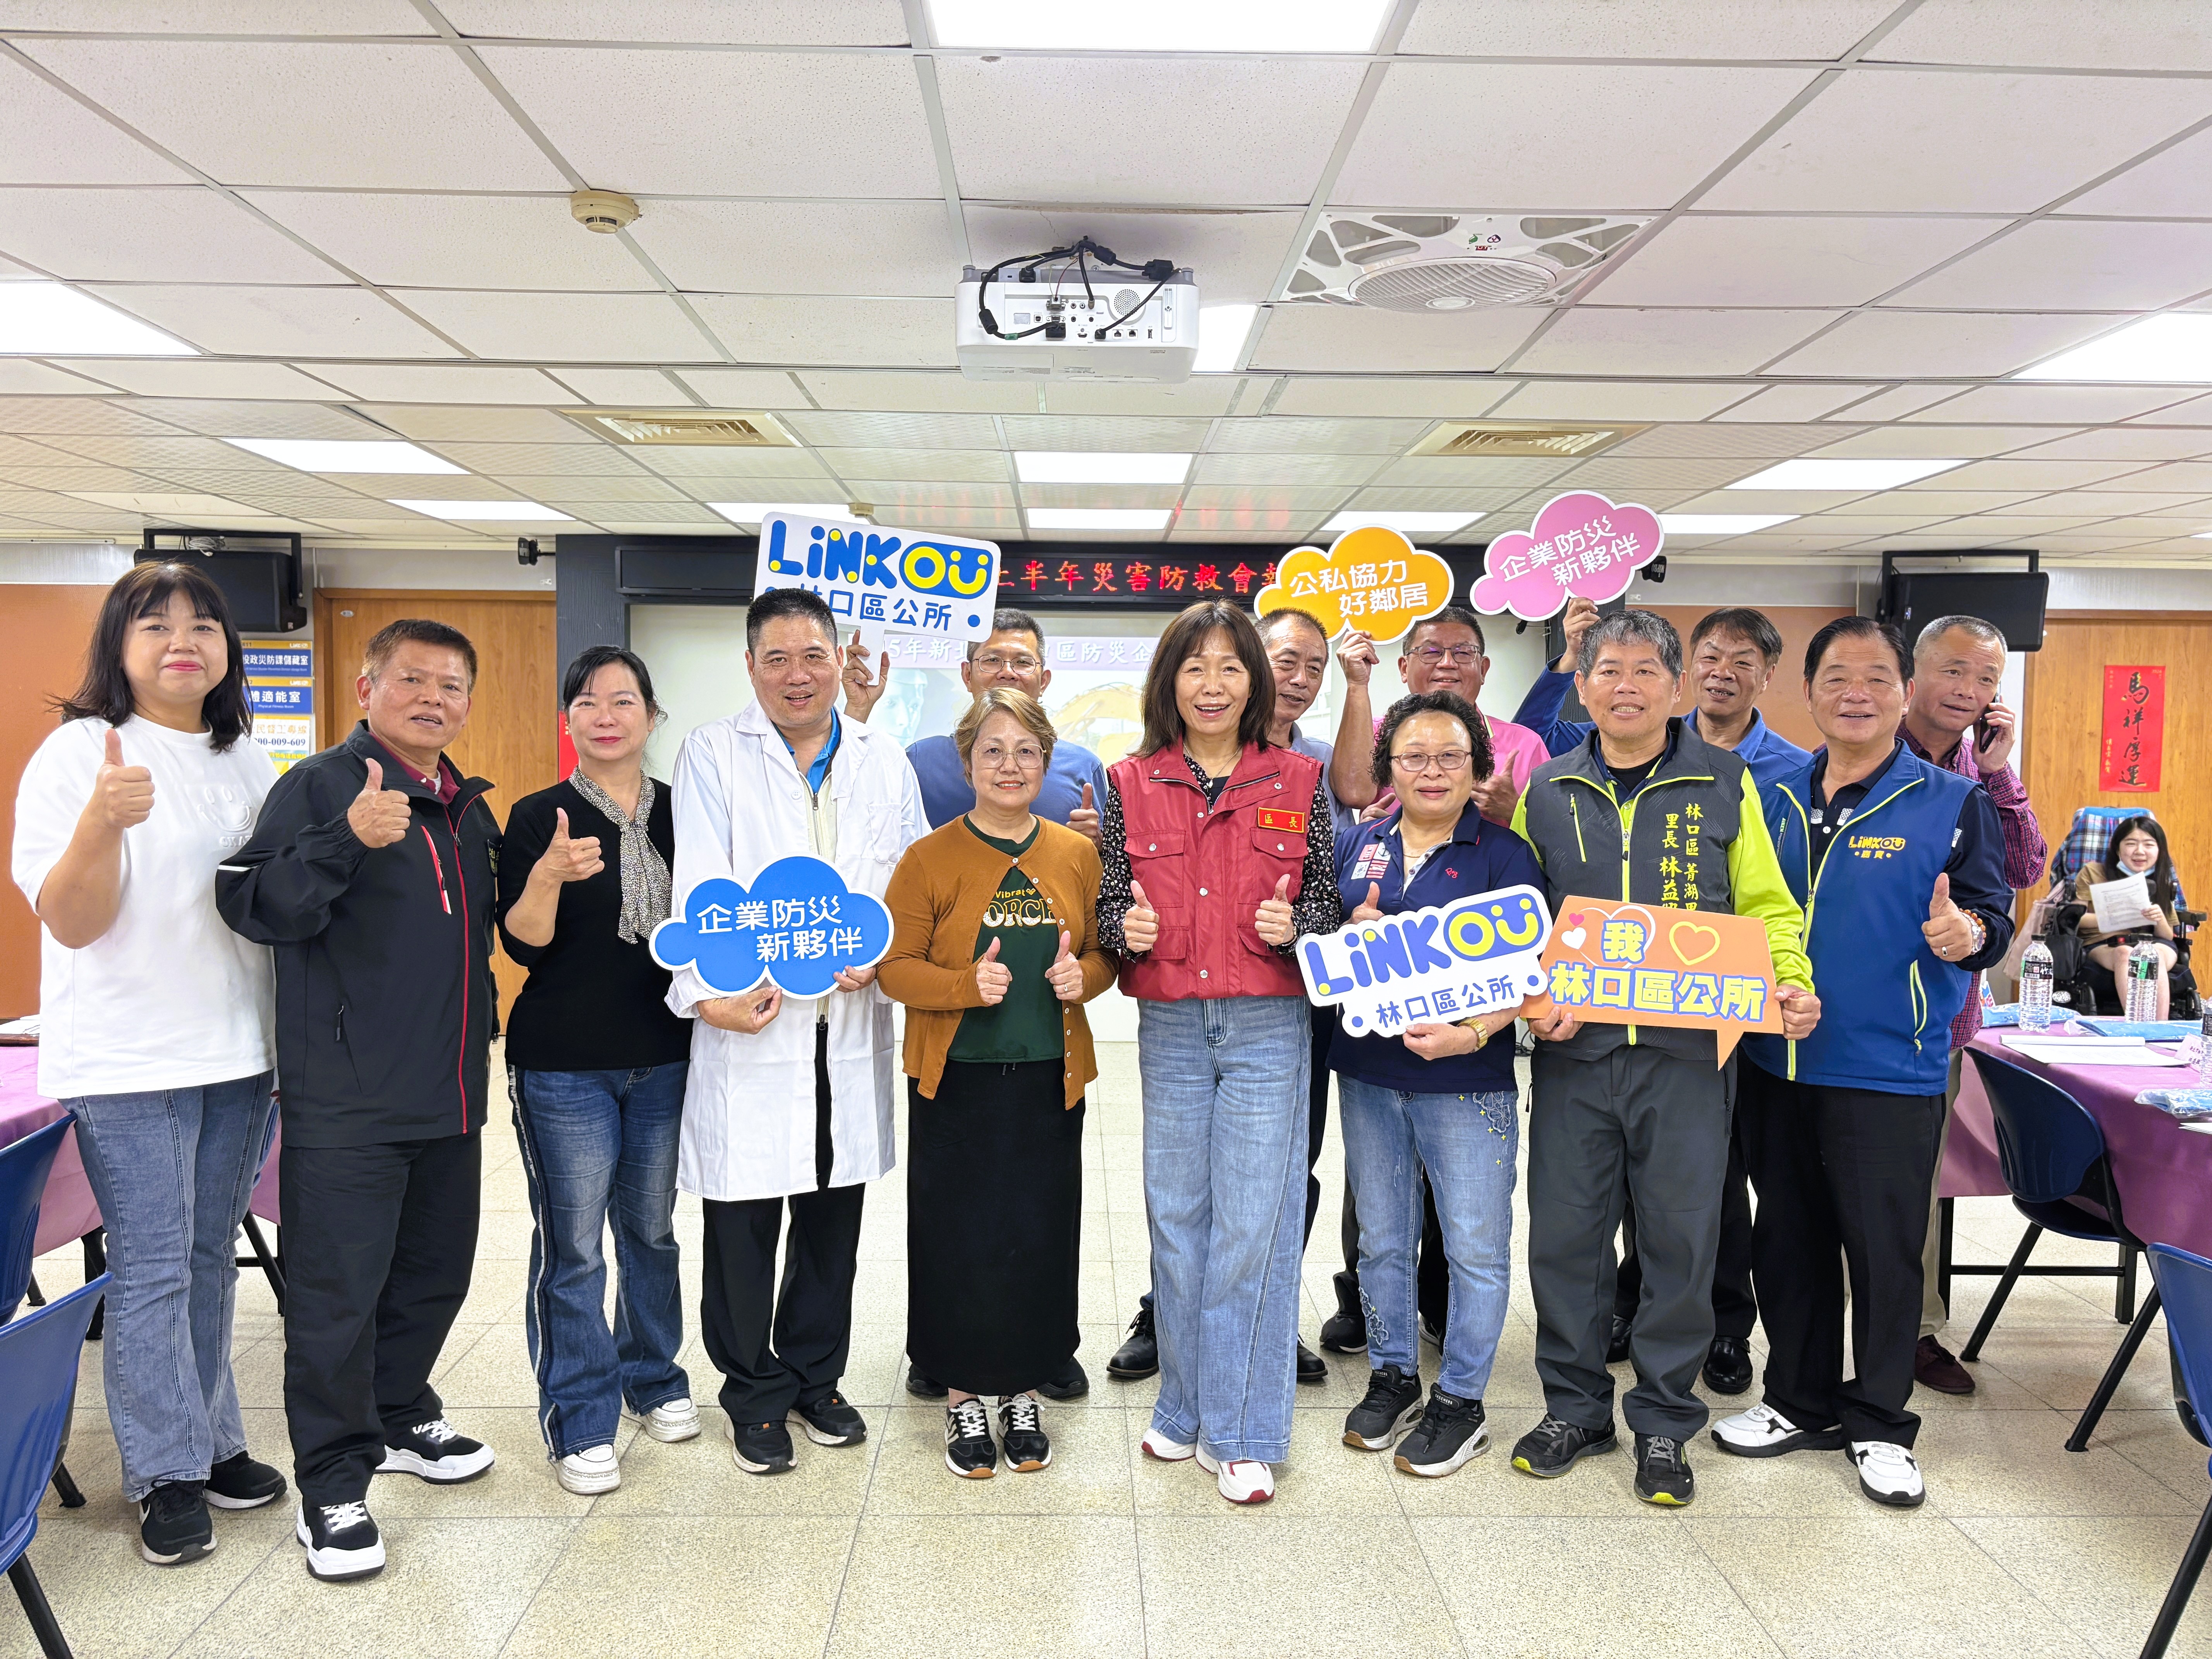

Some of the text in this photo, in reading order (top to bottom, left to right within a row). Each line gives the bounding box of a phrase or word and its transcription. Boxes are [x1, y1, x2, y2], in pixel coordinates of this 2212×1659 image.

[1499, 515, 1617, 582] 企業防災
[1551, 533, 1640, 586] 新夥伴
[1290, 560, 1408, 597] 公私協力
[800, 584, 951, 631] 口區公所
[1339, 582, 1428, 618] 好鄰居
[1264, 814, 1298, 828] 區長
[1662, 814, 1679, 848] 里長
[697, 895, 843, 934] 企業防災
[756, 927, 863, 962] 新夥伴
[1601, 920, 1647, 963] 我
[1376, 975, 1515, 1028] 林口區公所
[1549, 960, 1767, 1022] 林口區公所
